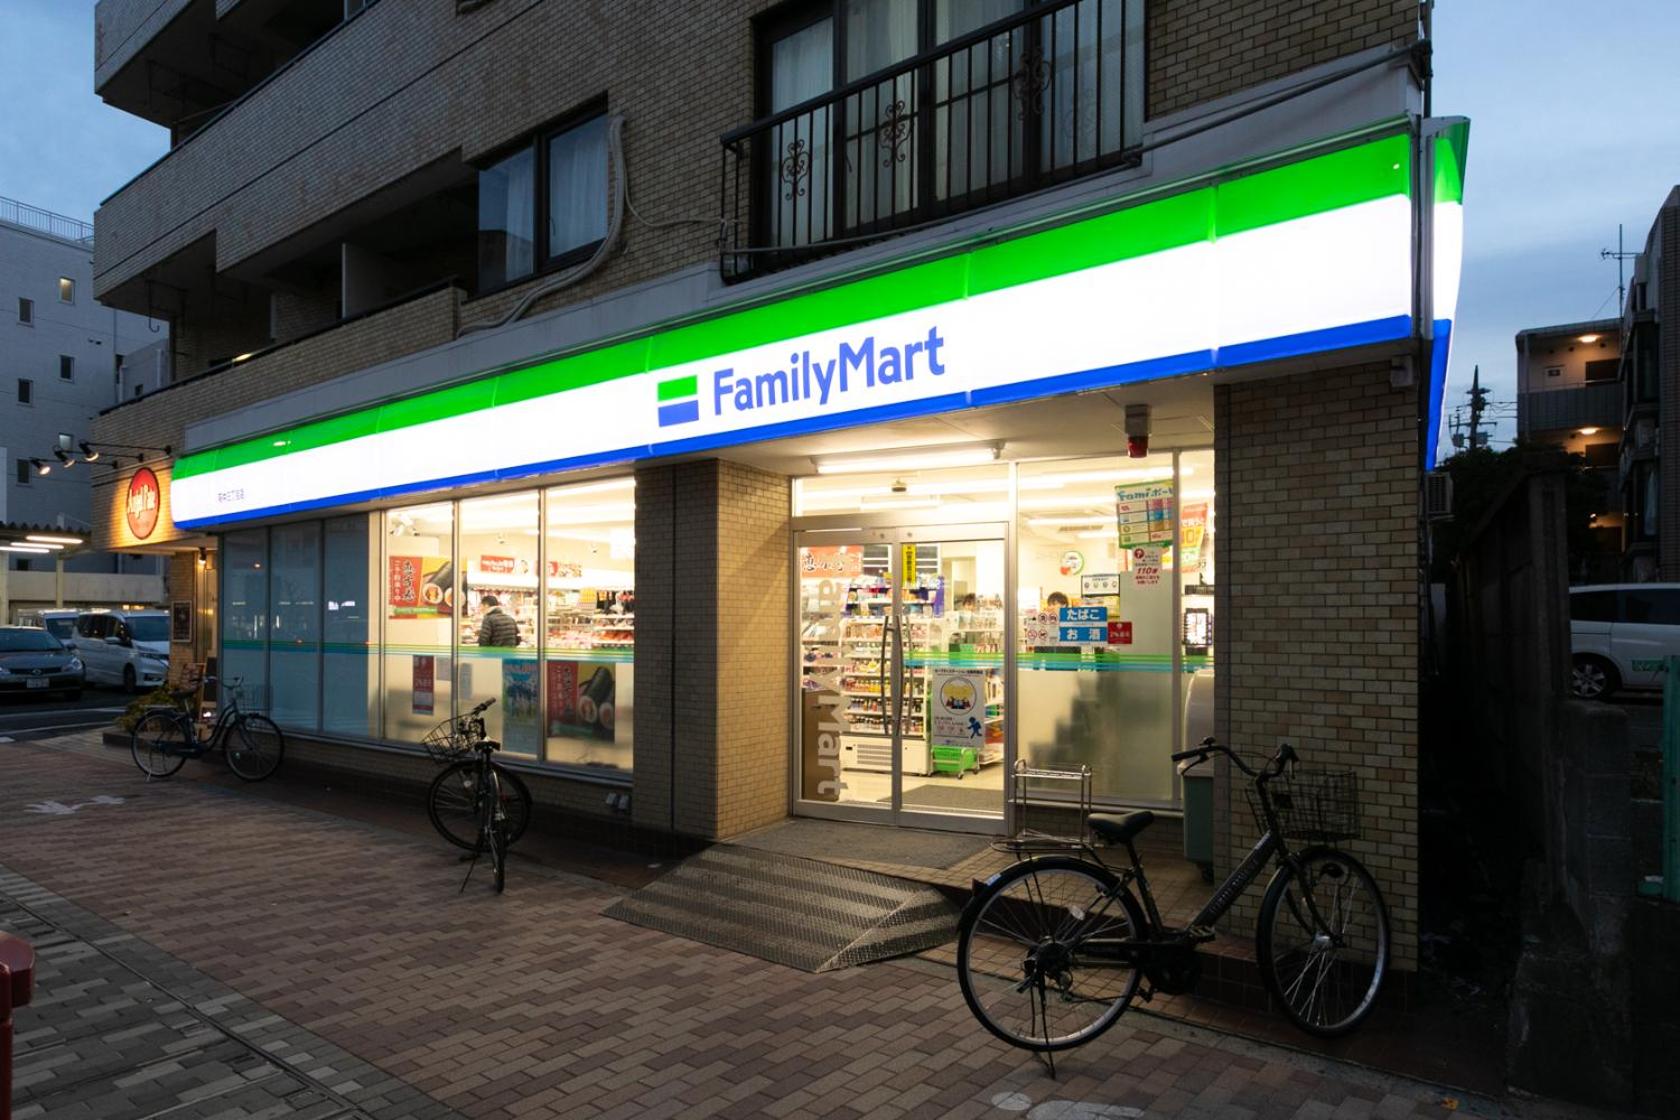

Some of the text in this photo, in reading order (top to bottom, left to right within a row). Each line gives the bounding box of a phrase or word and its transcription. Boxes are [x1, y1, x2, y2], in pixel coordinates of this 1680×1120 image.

[713, 326, 945, 416] FamilyMart
[1066, 609, 1100, 620] たばこ
[1066, 628, 1101, 640] お酒
[807, 579, 848, 796] amilyMart
